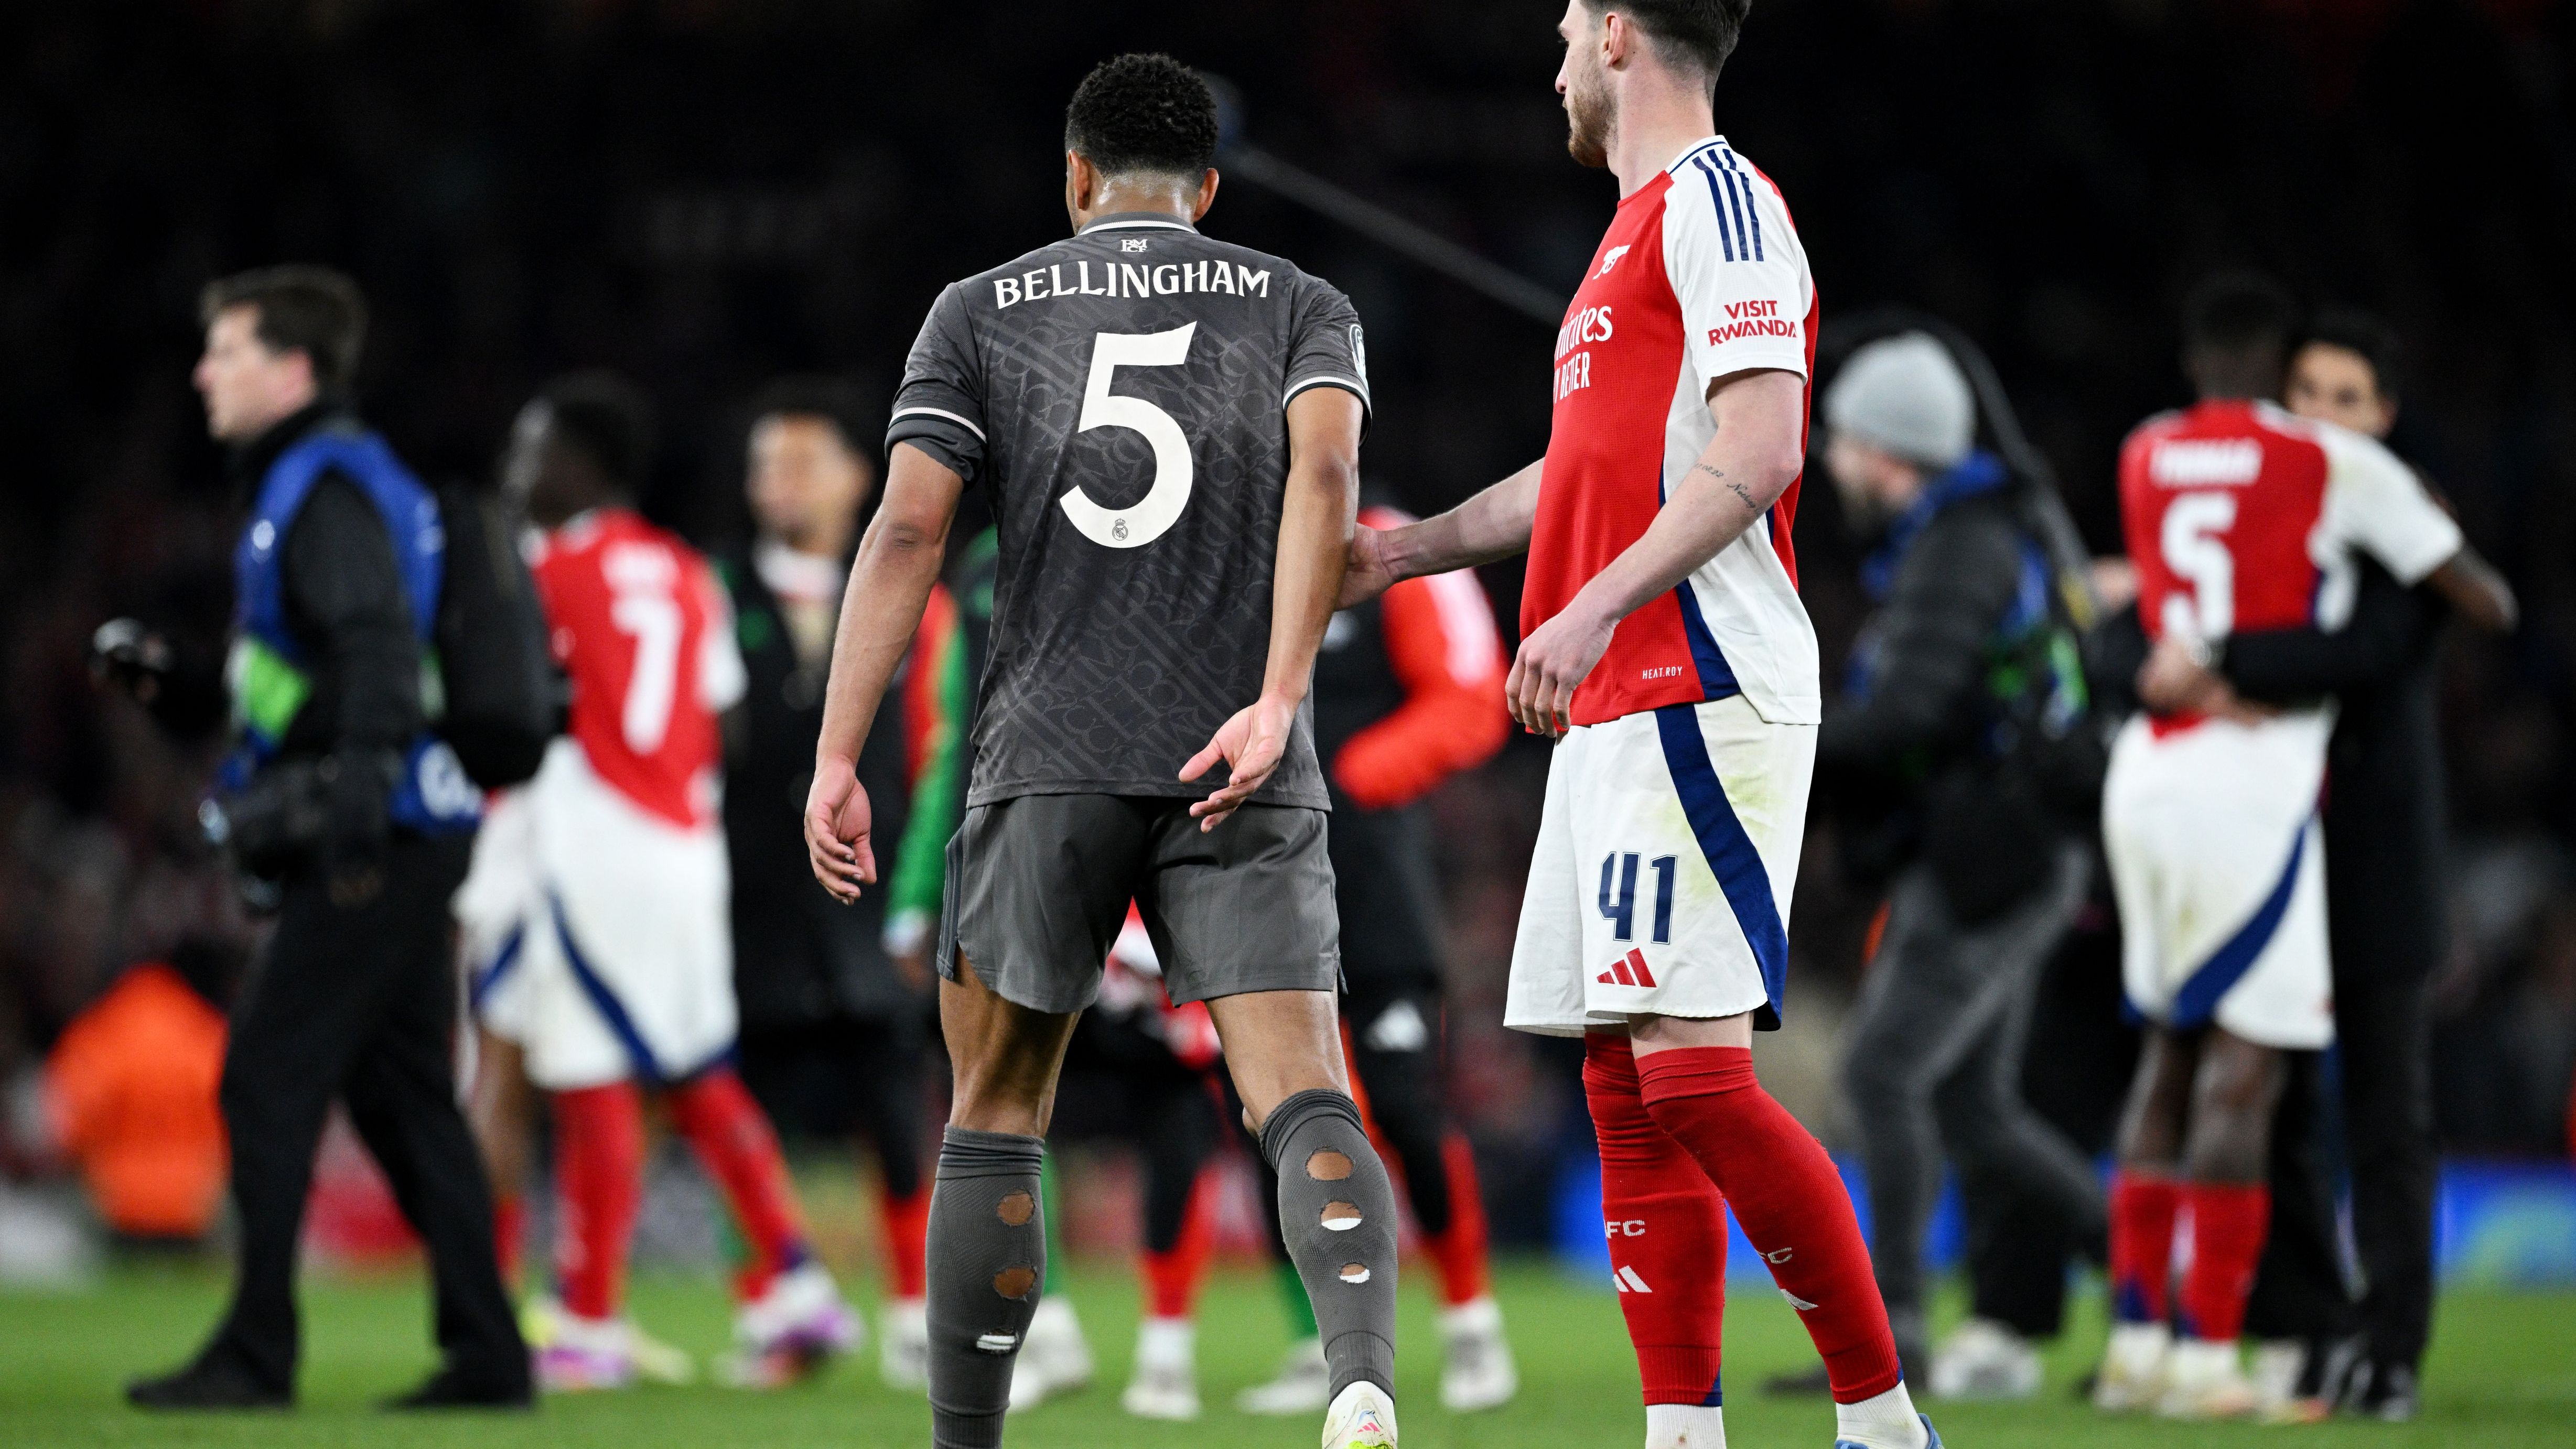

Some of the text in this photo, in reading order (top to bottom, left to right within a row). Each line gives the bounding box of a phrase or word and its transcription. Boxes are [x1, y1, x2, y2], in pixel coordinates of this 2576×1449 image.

[994, 260, 1271, 309] BELLINGHAM
[1724, 300, 1777, 319] VISIT
[1554, 303, 1613, 362] mirates
[1708, 320, 1797, 347] RWANDA
[1060, 321, 1197, 548] 5
[2159, 490, 2236, 643] 5
[1597, 851, 1677, 945] 41
[1604, 1219, 1645, 1239] FC
